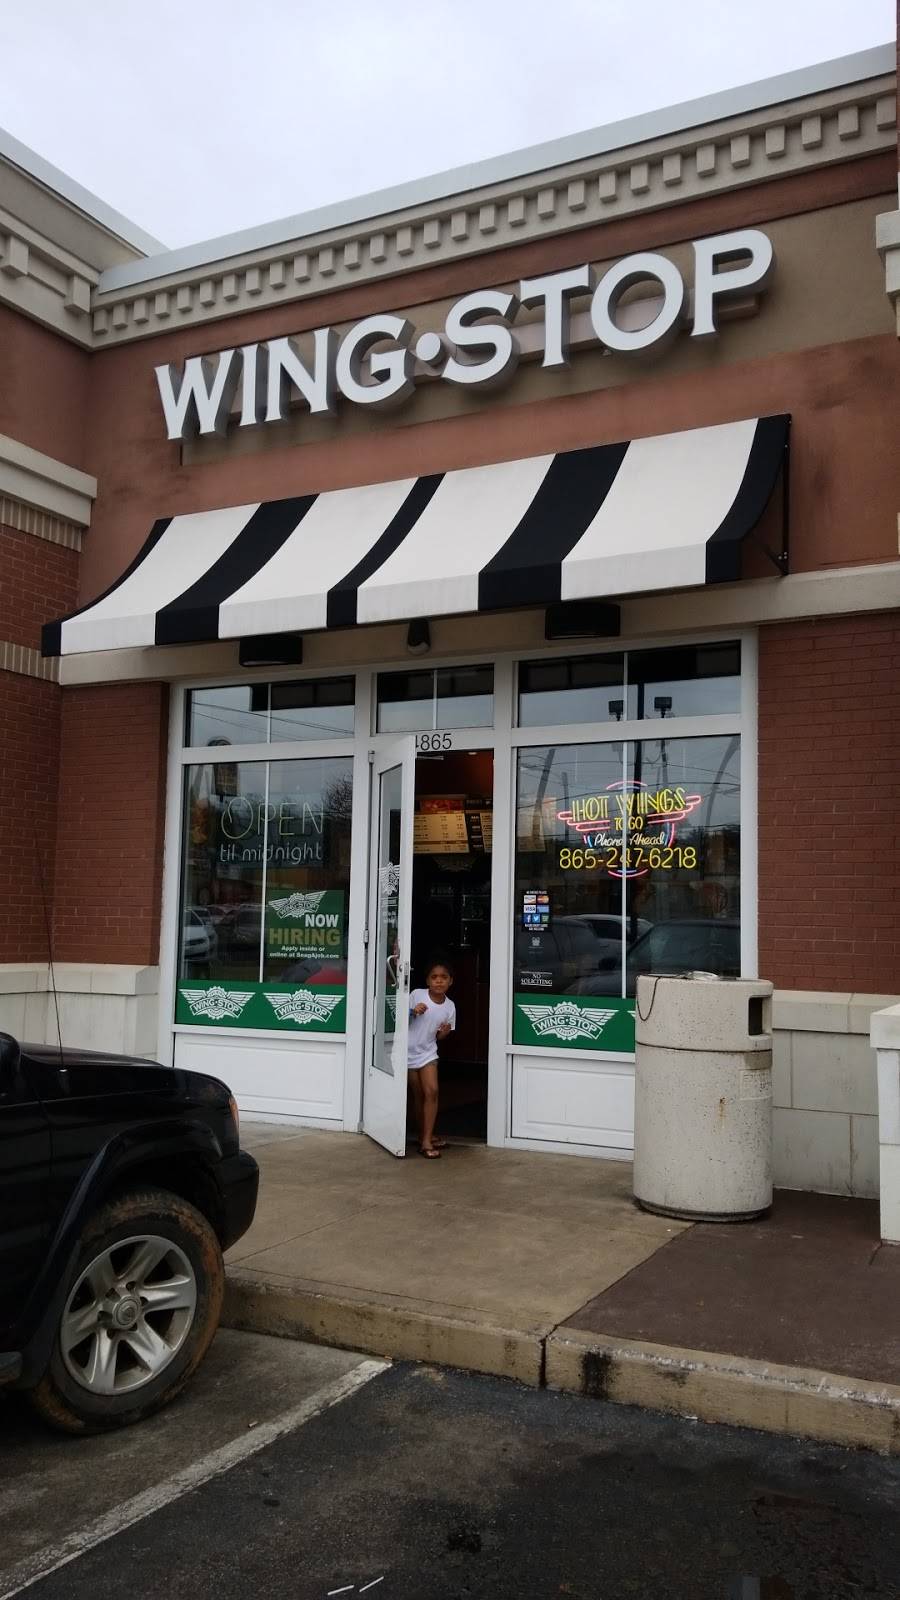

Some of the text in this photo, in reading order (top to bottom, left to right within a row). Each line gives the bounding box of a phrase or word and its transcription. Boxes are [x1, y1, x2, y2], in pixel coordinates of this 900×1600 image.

[572, 787, 686, 822] HOT WINGS
[221, 797, 324, 839] OPEN
[628, 816, 644, 831] GO
[629, 832, 665, 846] Ahead
[242, 842, 322, 865] midnight
[559, 847, 697, 869] 865-247-6218
[304, 914, 339, 928] NOW
[269, 928, 341, 946] HIRING
